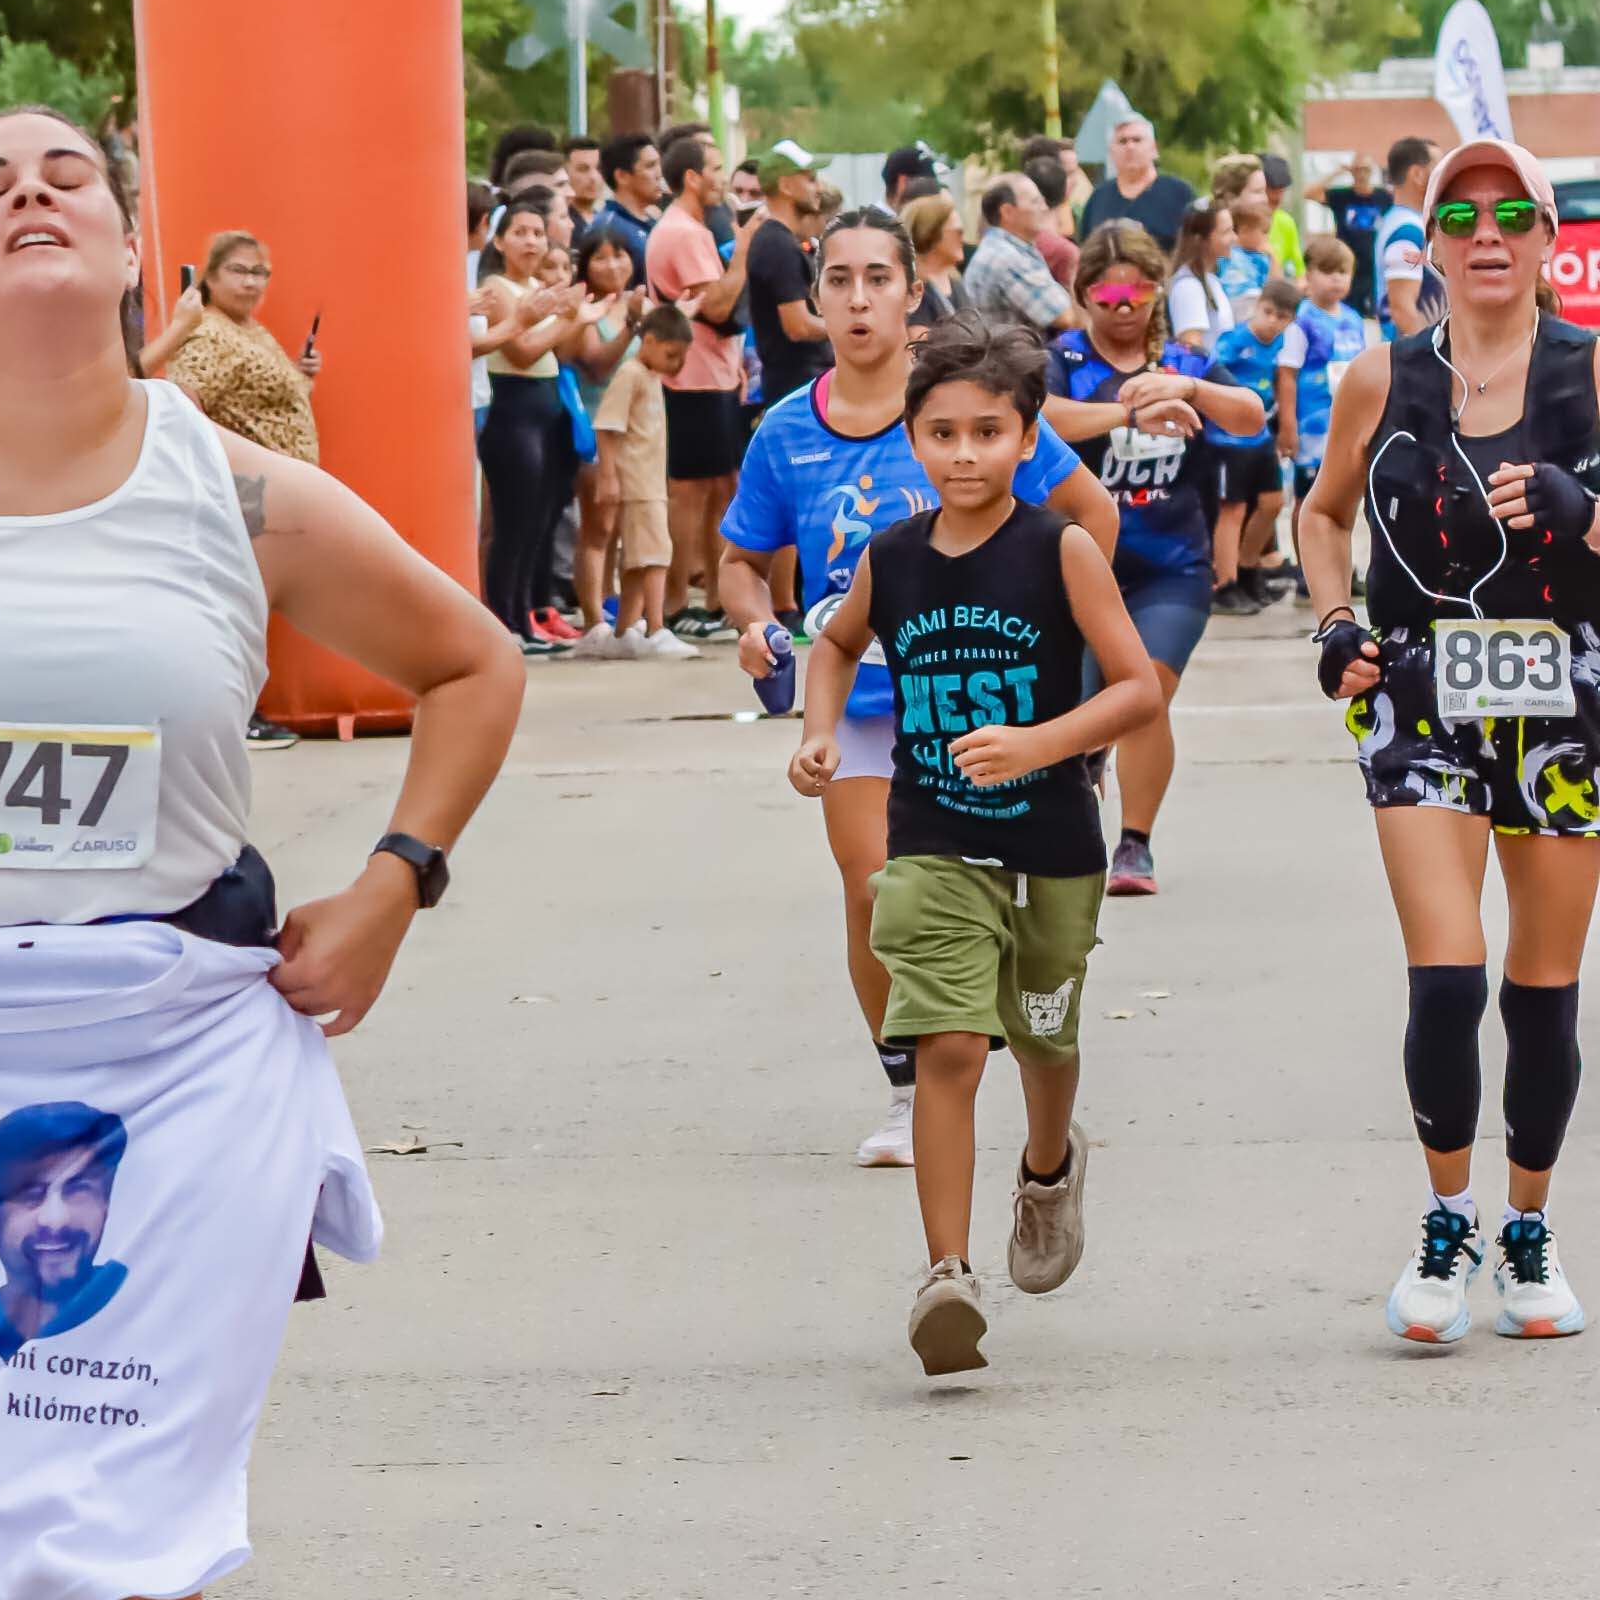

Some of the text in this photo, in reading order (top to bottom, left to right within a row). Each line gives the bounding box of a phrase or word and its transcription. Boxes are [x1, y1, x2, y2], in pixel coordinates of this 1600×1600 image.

[895, 607, 947, 658] MIAMI
[954, 606, 1041, 648] BEACH
[1445, 629, 1562, 692] 863
[71, 839, 138, 853] CARUSO
[46, 1355, 160, 1387] corazón,
[7, 1391, 148, 1428] kilómetro.
